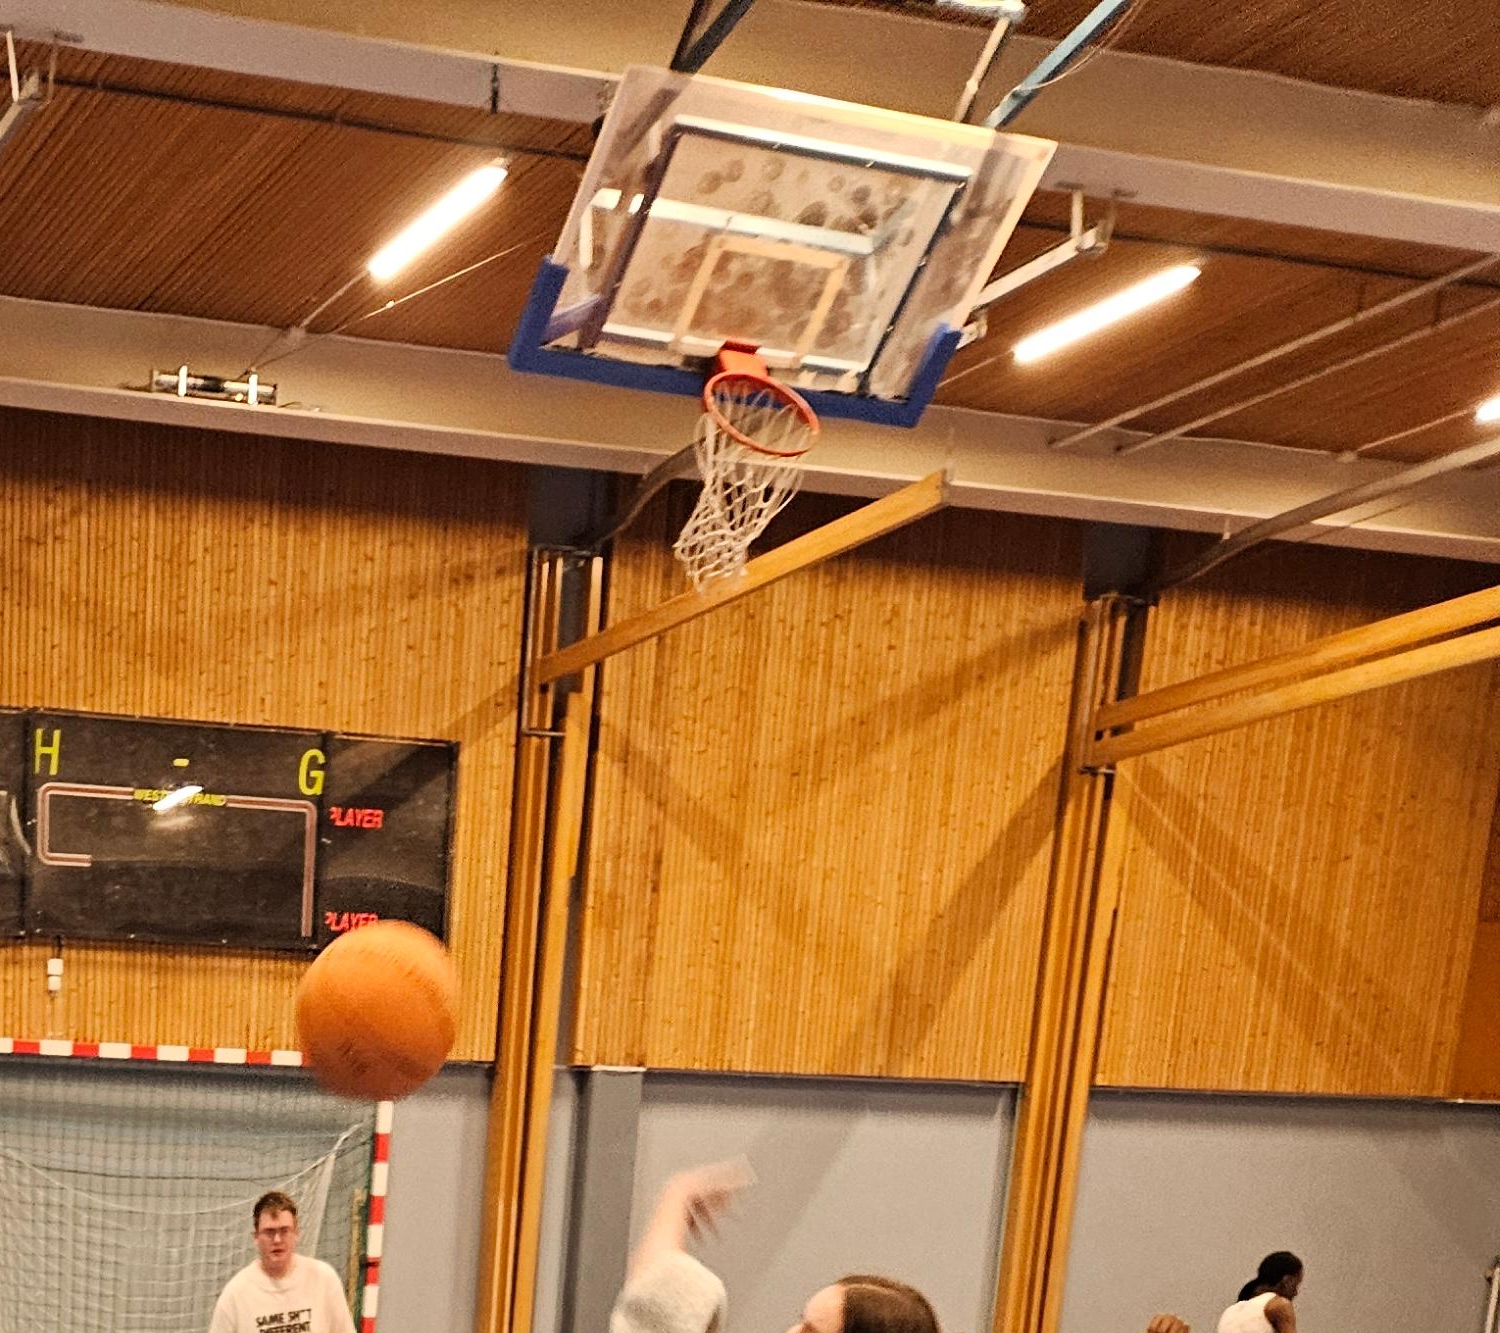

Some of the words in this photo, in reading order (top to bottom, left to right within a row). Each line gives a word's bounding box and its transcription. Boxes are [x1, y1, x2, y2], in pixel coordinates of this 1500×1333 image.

[35, 728, 61, 775] H
[298, 748, 325, 796] G
[256, 1313, 284, 1327] SAME
